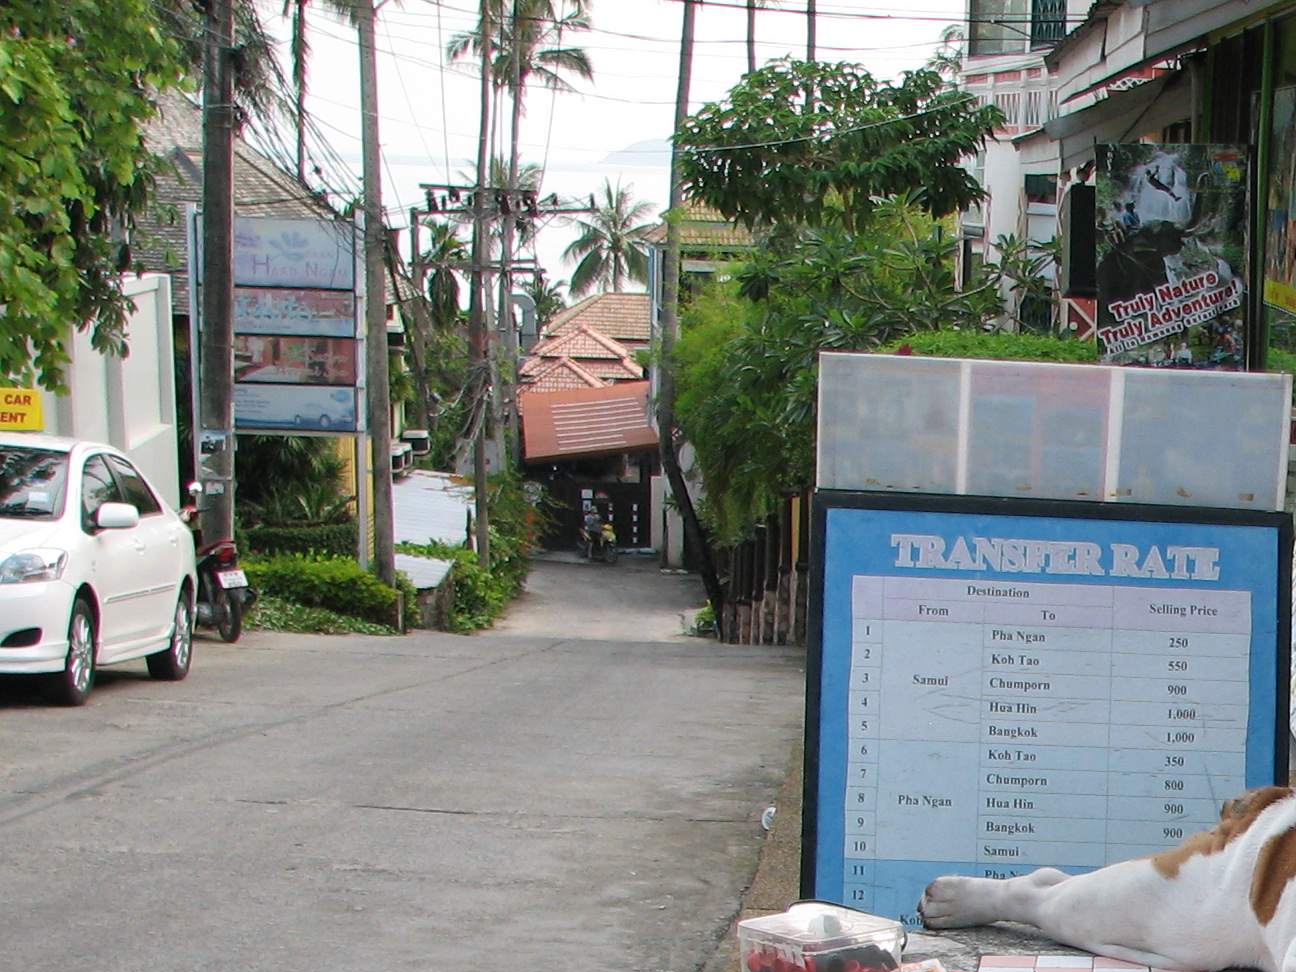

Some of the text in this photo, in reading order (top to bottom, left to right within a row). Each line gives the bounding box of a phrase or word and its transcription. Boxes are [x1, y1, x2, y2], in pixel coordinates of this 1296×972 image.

[1108, 271, 1218, 322] Truly Nature
[1098, 318, 1145, 348] Truly
[1149, 278, 1242, 329] Adventure!
[4, 393, 32, 406] CAR
[0, 411, 27, 424] ENT
[891, 533, 1221, 580] TRANSFER RATE
[967, 585, 1030, 599] Destination
[918, 604, 949, 616] From
[1041, 610, 1056, 621] To
[1149, 604, 1218, 618] Selling Price
[865, 625, 872, 636] 1
[992, 629, 1046, 645] Pha Ngan
[1168, 637, 1189, 649] 250
[864, 648, 871, 660] 2
[991, 653, 1040, 666] Koh Tao
[1168, 660, 1188, 672] 550
[862, 672, 869, 684] 3
[912, 674, 949, 686] Samui
[989, 677, 1051, 693] Chumporn
[1167, 684, 1187, 696] 900
[861, 697, 868, 708] 4
[989, 701, 1037, 714] Hua Hin
[1168, 708, 1196, 720] 1,000
[861, 720, 868, 732] 5
[988, 725, 1038, 739] Bangkok
[1167, 731, 1195, 743] 1,000
[860, 745, 868, 756] 6
[988, 749, 1037, 762] Koh Tao
[1164, 755, 1185, 767] 350
[860, 768, 867, 779] 7
[986, 773, 1048, 788] Chumporn
[1164, 779, 1184, 791] 800
[857, 792, 865, 803] 8
[898, 794, 953, 809] Pha Ngan
[986, 797, 1034, 810] Hua Hin
[1163, 803, 1184, 815] 900
[857, 817, 865, 828] 9
[986, 821, 1035, 836] Bangkok
[1163, 827, 1183, 839] 900
[854, 841, 867, 852] 10
[983, 845, 1019, 857] Samui
[853, 864, 865, 876] 11
[852, 889, 865, 901] 12
